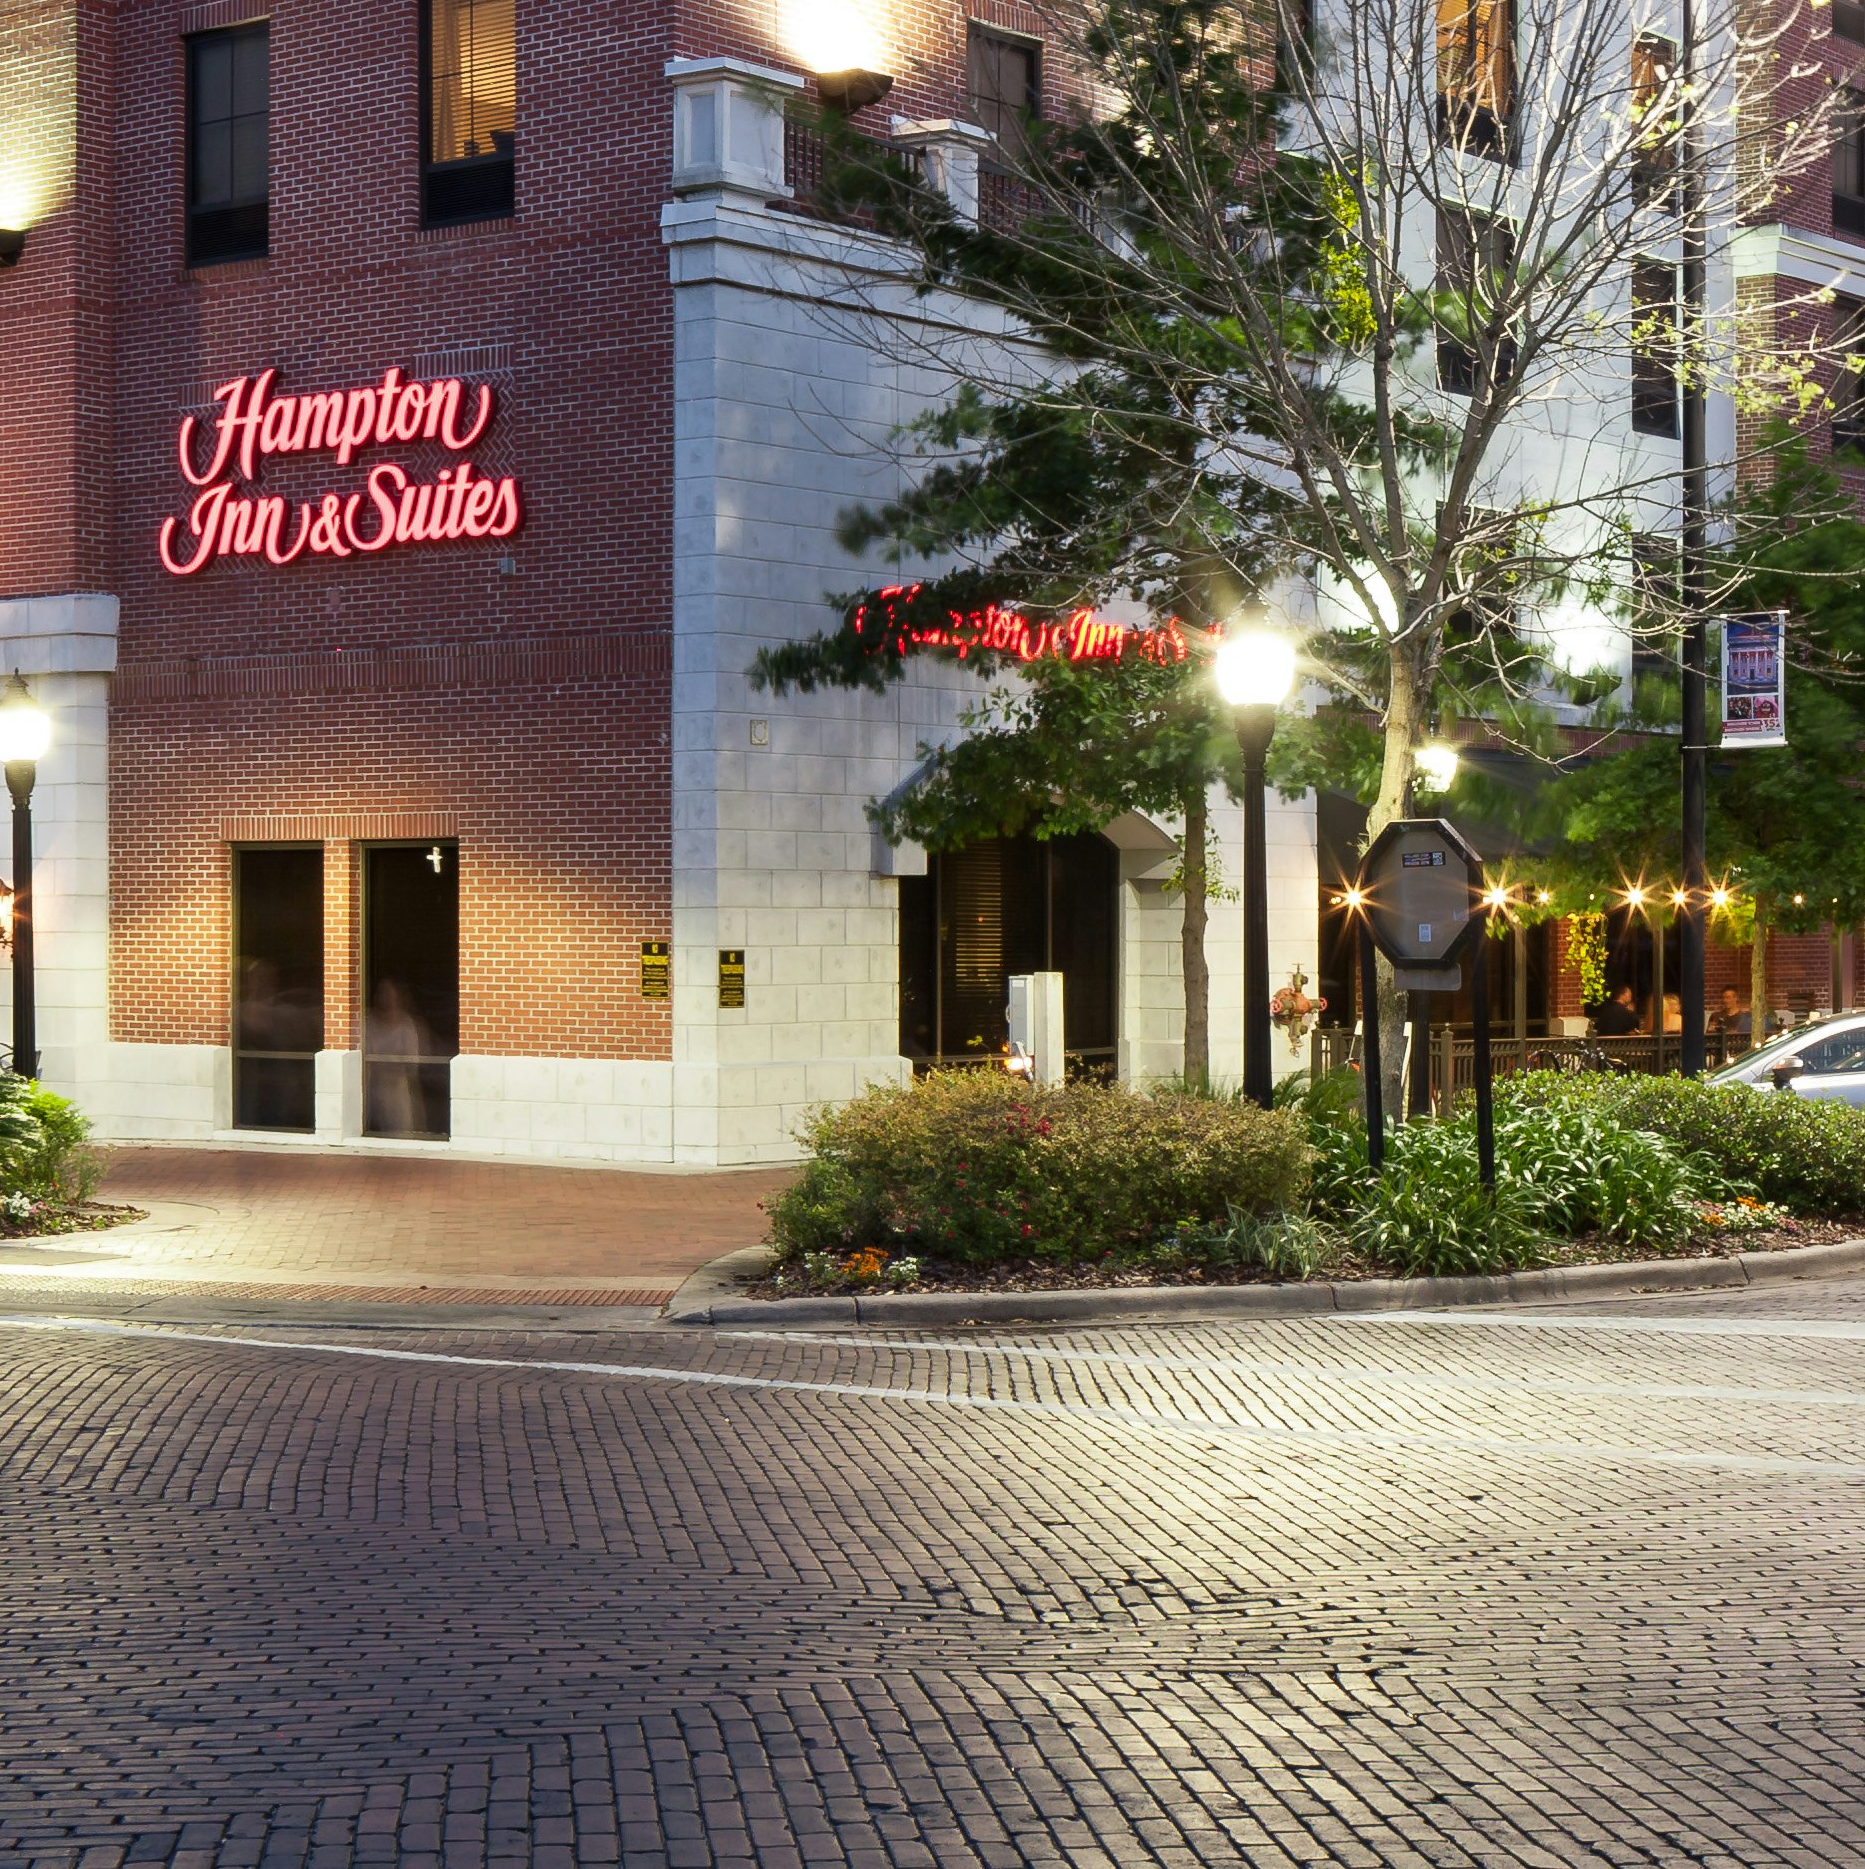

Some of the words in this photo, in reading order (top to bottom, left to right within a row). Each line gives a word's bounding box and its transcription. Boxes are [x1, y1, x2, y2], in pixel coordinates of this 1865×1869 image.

[179, 367, 495, 486] Hampton
[159, 481, 312, 576] Inn
[310, 493, 352, 557] &
[344, 462, 524, 551] Suites
